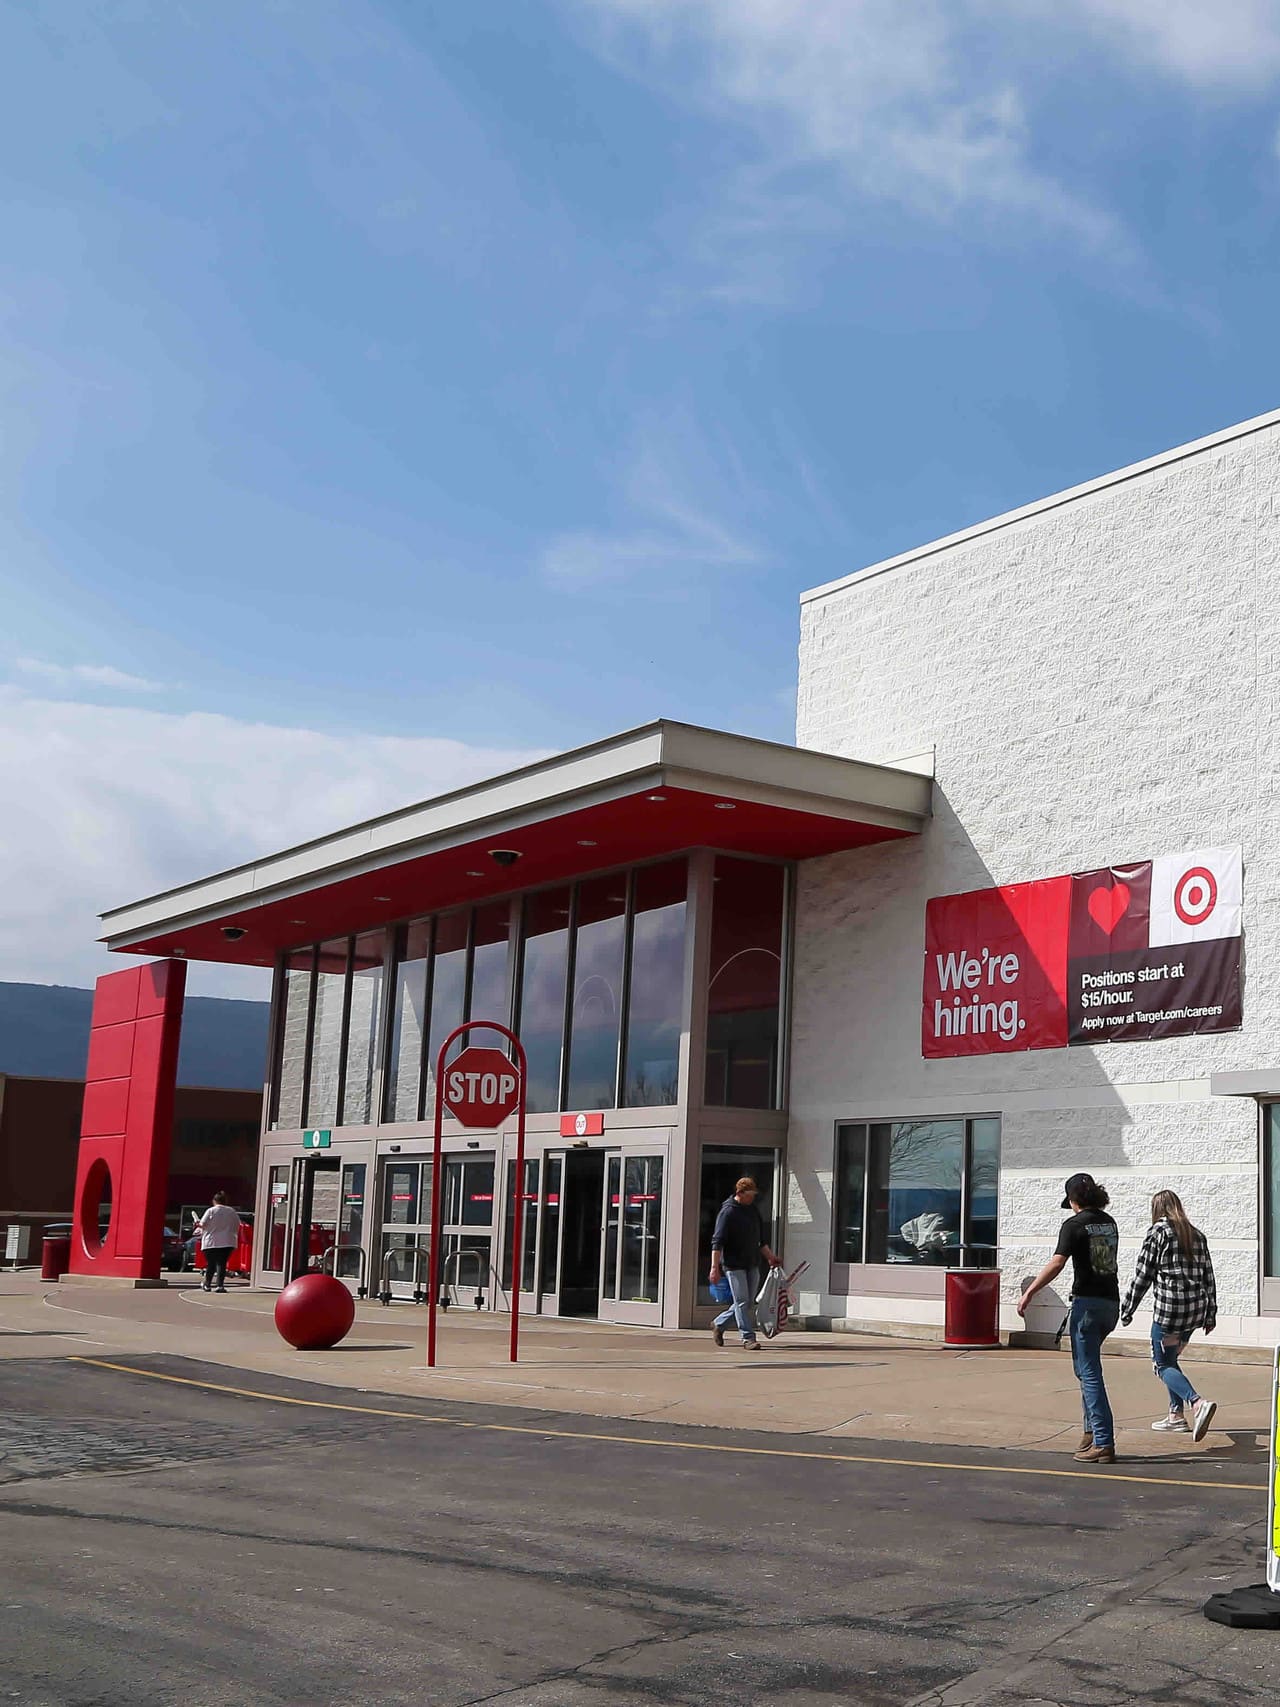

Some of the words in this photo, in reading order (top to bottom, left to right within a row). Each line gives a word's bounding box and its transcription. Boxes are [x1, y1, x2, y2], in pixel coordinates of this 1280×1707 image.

[936, 948, 1019, 991] We're
[1081, 971, 1135, 989] Positions
[1138, 964, 1169, 982] start
[1171, 962, 1185, 978] at
[1081, 990, 1134, 1008] $15/hour.
[934, 994, 1026, 1041] hiring.
[1081, 1016, 1105, 1030] Apply
[1106, 1016, 1124, 1026] now
[1126, 1014, 1135, 1024] at
[1135, 1005, 1223, 1024] Target.com/careers
[448, 1071, 516, 1105] STOP
